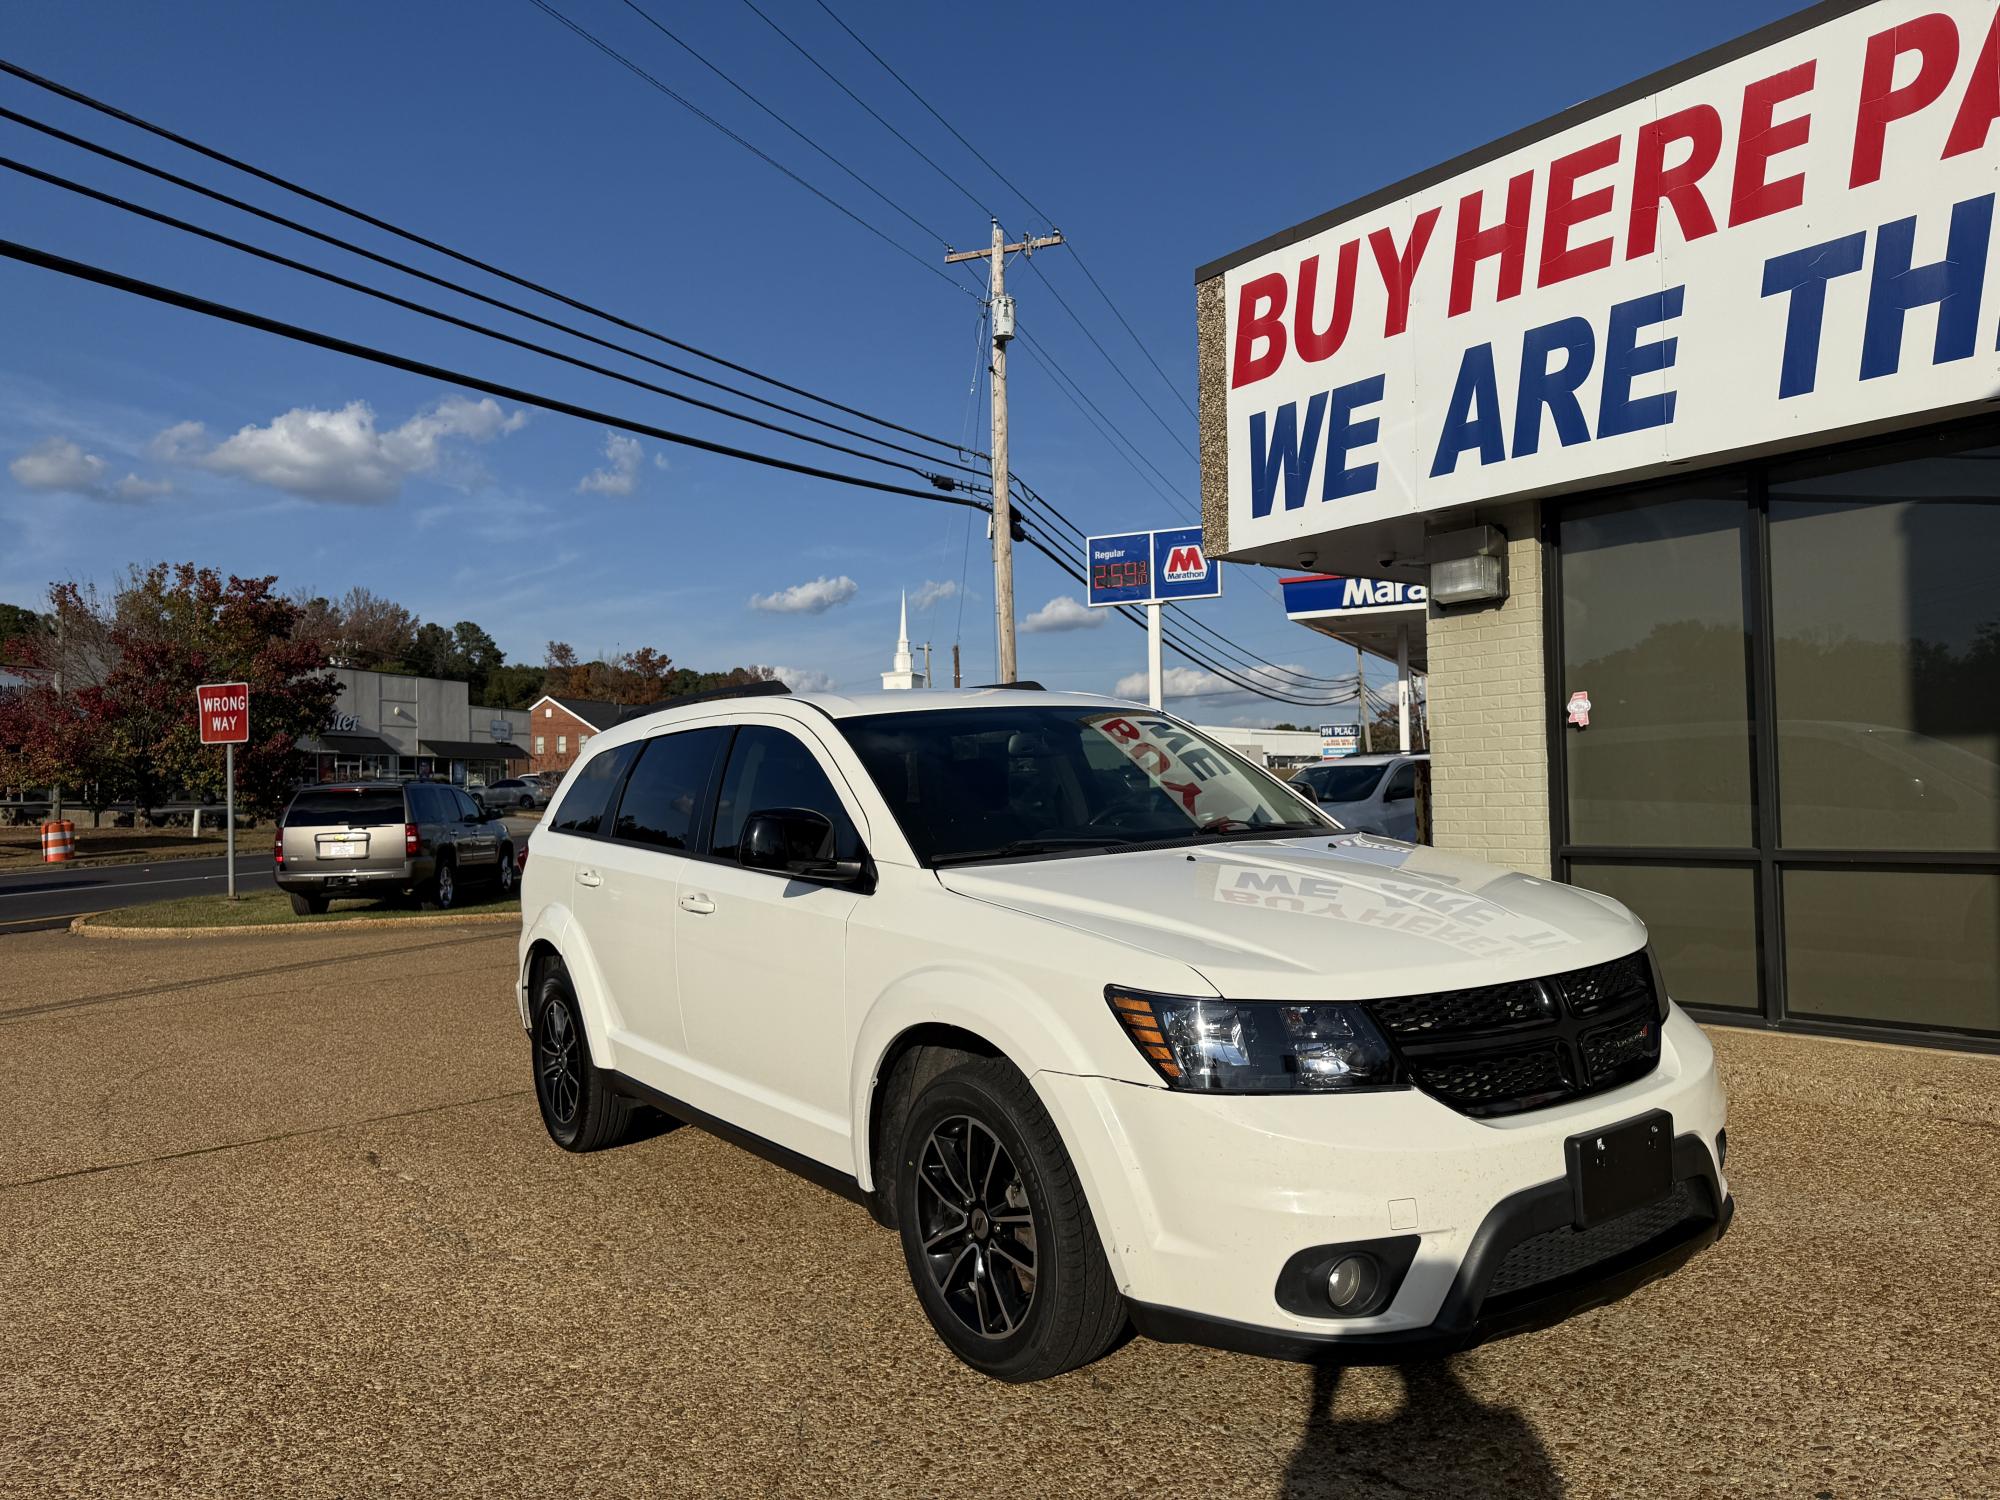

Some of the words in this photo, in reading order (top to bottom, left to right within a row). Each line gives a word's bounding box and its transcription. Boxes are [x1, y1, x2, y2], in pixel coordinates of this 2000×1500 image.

[1231, 206, 1442, 389] BUY
[1447, 59, 1817, 318] HERE
[1249, 374, 1386, 519] WE
[1429, 285, 1686, 479] ARE
[1760, 192, 2000, 400] TH
[1095, 549, 1125, 560] Regular
[1094, 562, 1137, 589] 2.59
[1167, 571, 1204, 580] Marathon
[203, 696, 245, 712] WRONG
[212, 716, 237, 731] WAY
